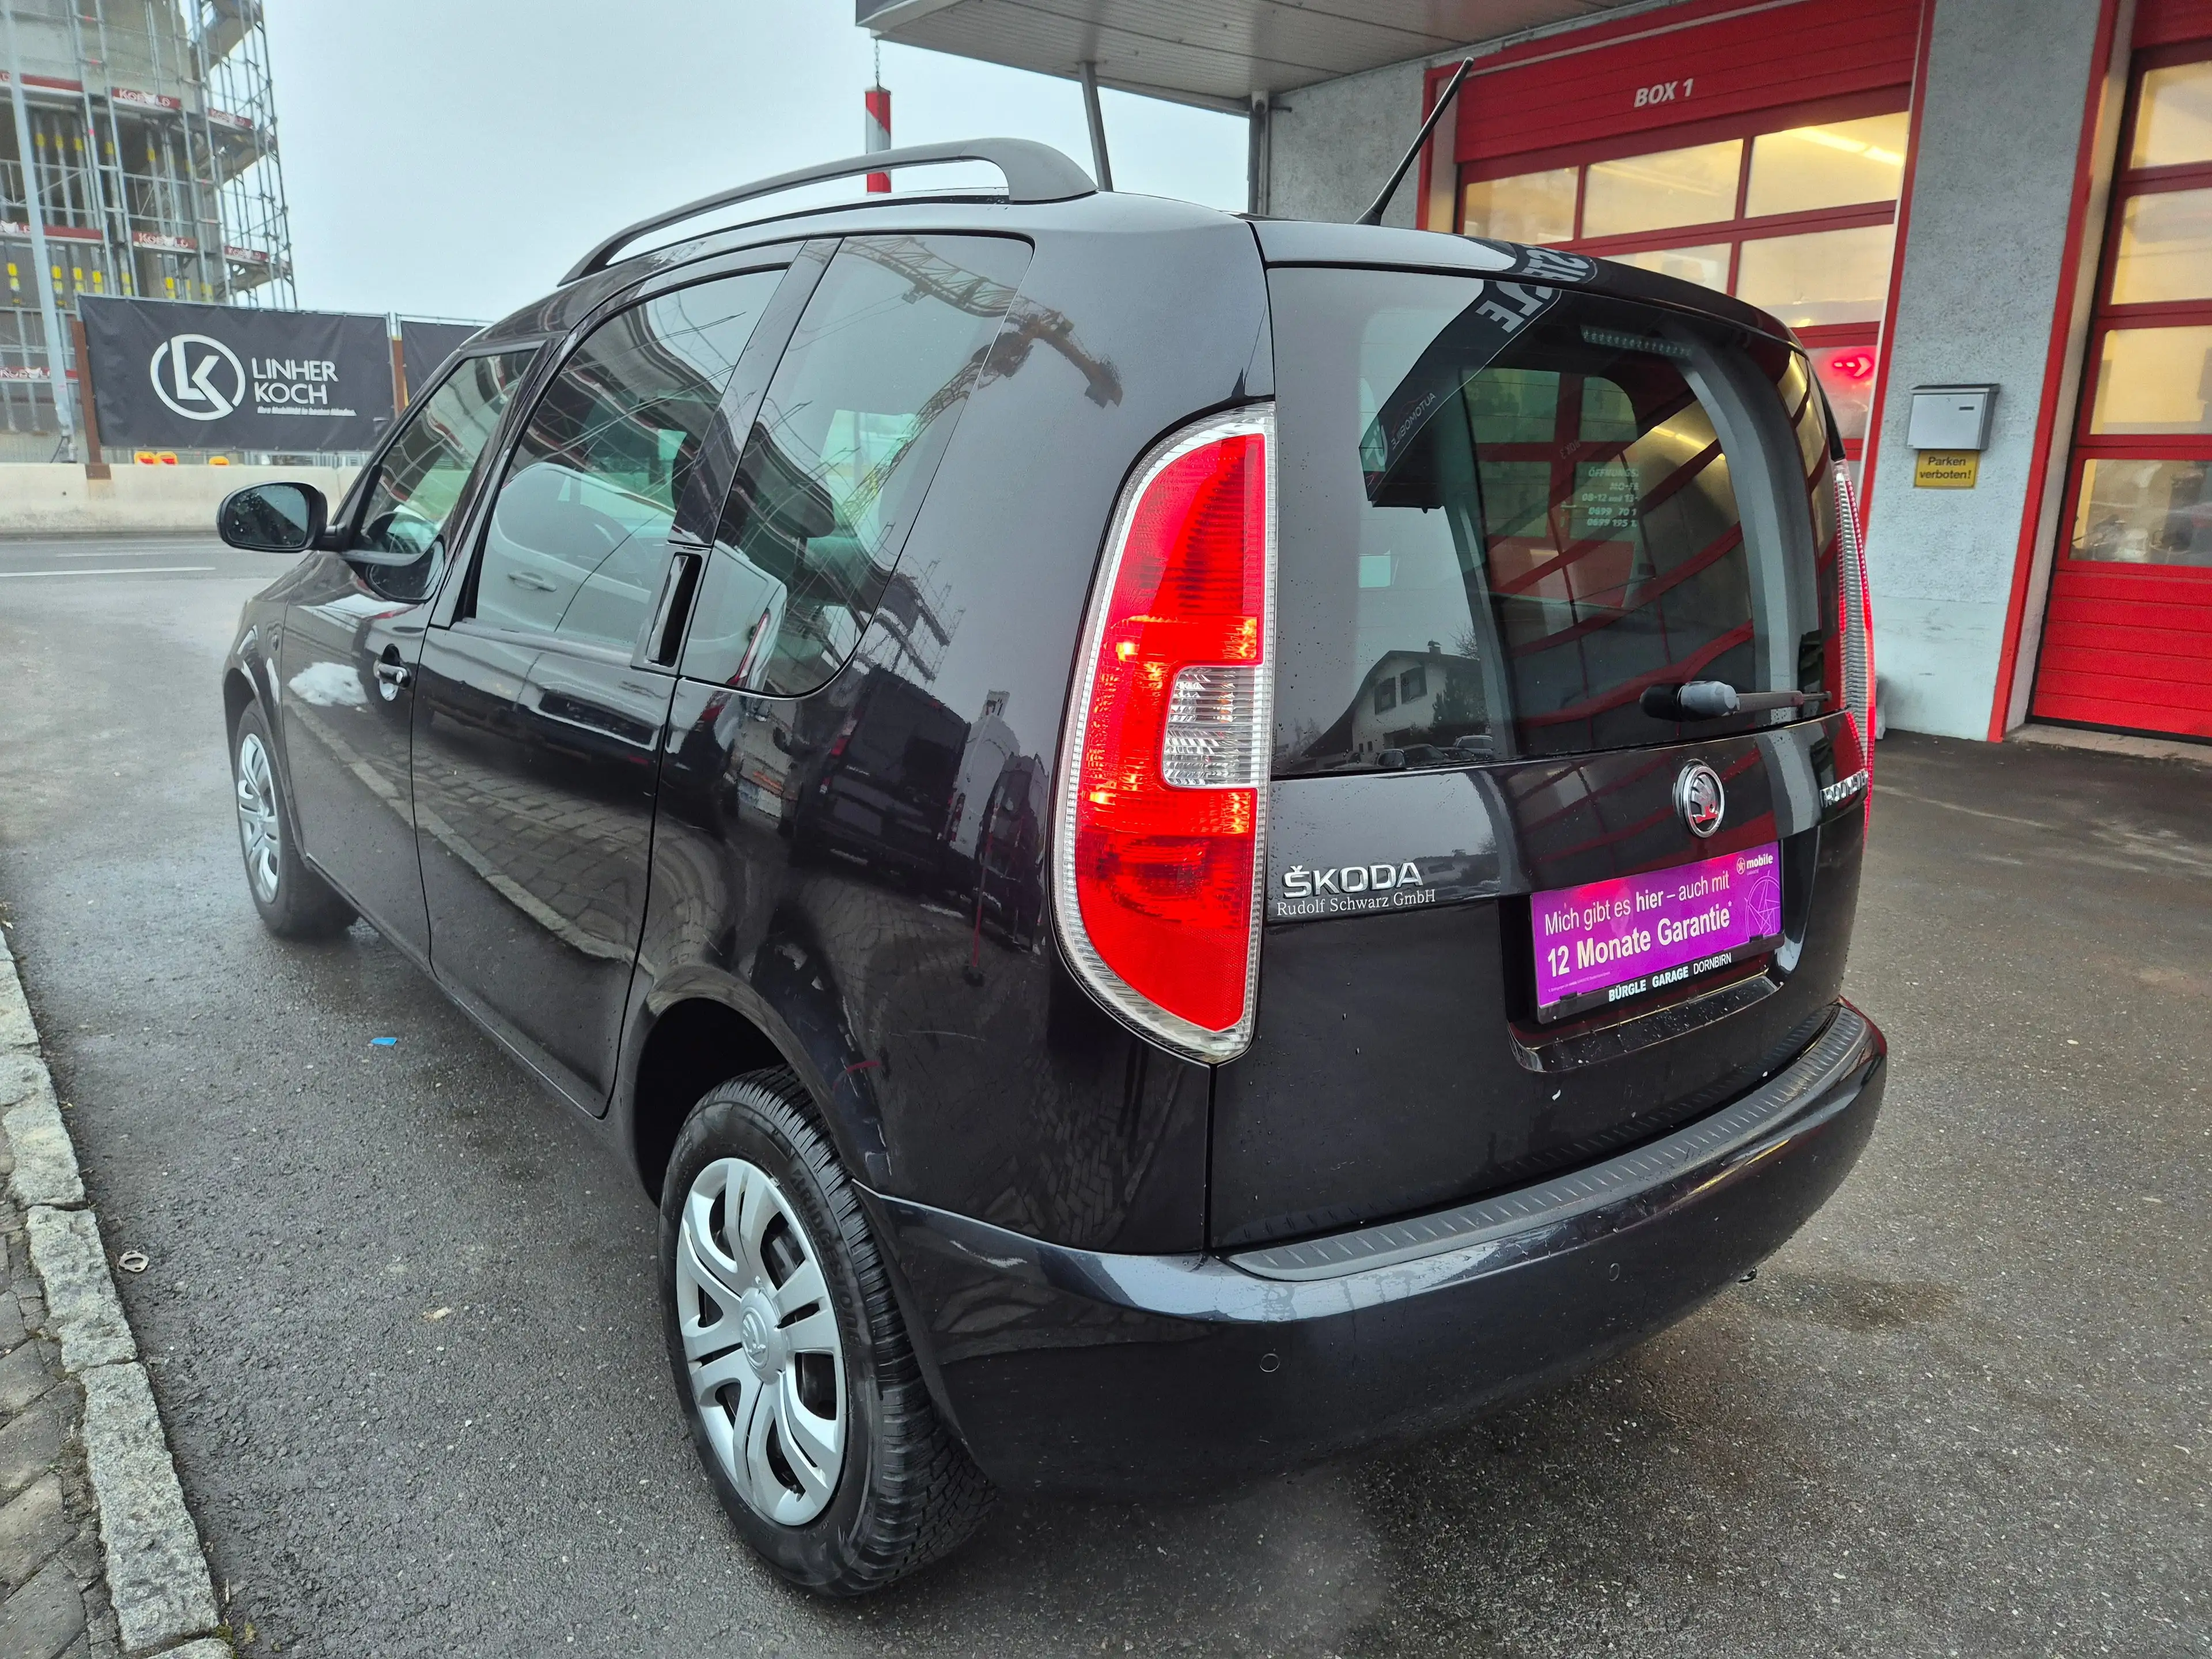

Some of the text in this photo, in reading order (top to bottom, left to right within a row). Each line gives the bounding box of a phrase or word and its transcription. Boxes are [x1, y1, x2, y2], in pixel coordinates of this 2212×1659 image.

[1634, 78, 1694, 108] BOX 1
[251, 357, 339, 382] LINHER
[253, 381, 328, 405] KOCH
[1919, 469, 1972, 479] verboten!
[1927, 456, 1967, 466] Parken
[1746, 853, 1774, 869] mobile
[1283, 862, 1424, 899] ŠKODA
[1277, 889, 1436, 916] Rudolf Schwarz GmbH
[1545, 908, 1580, 937] Mich
[1583, 900, 1611, 931] gibt
[1614, 899, 1631, 917] es
[1636, 889, 1664, 912] hier
[1679, 876, 1709, 902] auch
[1711, 869, 1730, 893] mit
[1547, 945, 1570, 978] 12
[1577, 927, 1652, 969] Monate
[1609, 979, 1647, 1002] BÜRGLE
[1652, 965, 1689, 988] GARAGE
[1693, 952, 1732, 975] DORNBIRN
